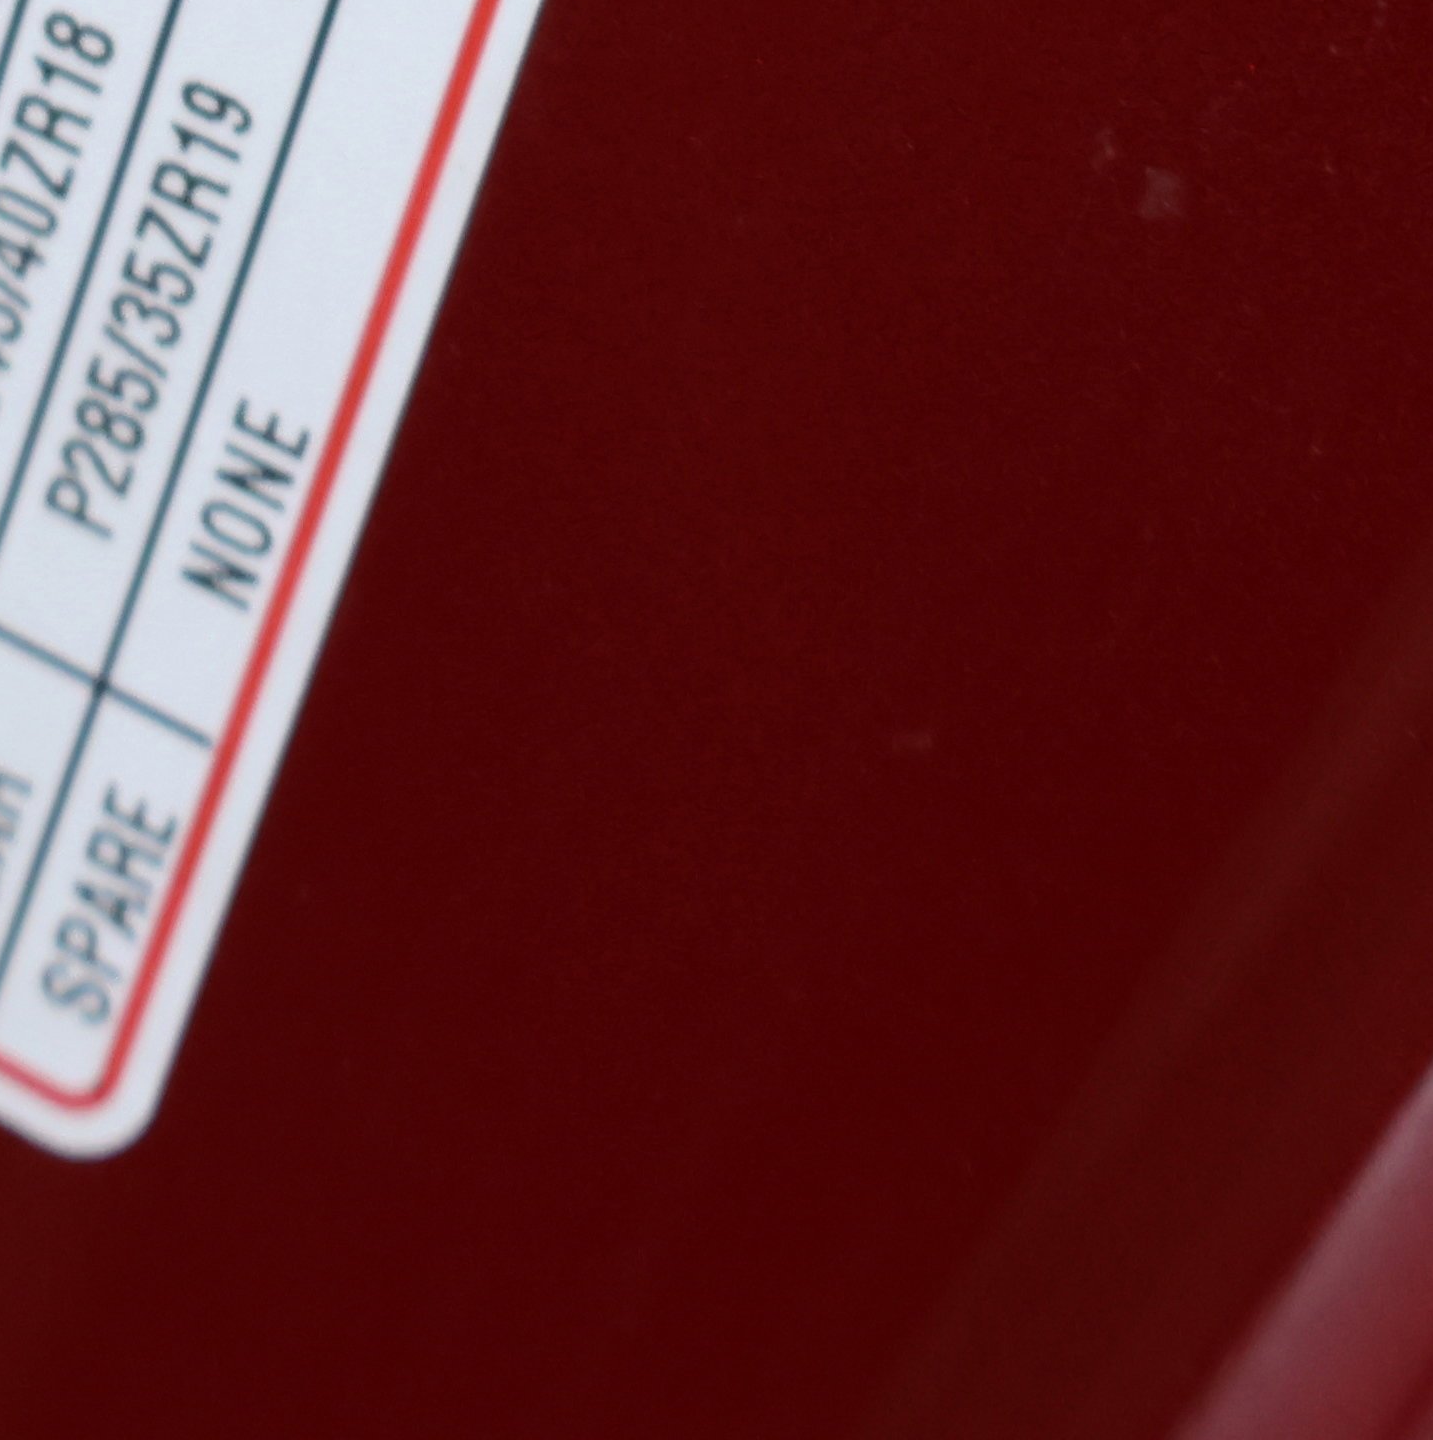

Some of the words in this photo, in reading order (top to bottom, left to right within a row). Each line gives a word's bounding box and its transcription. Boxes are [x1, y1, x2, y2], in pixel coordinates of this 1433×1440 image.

[46, 79, 253, 540] P285/35ZR19
[183, 398, 311, 613] NONE
[39, 783, 179, 1029] SPARE
